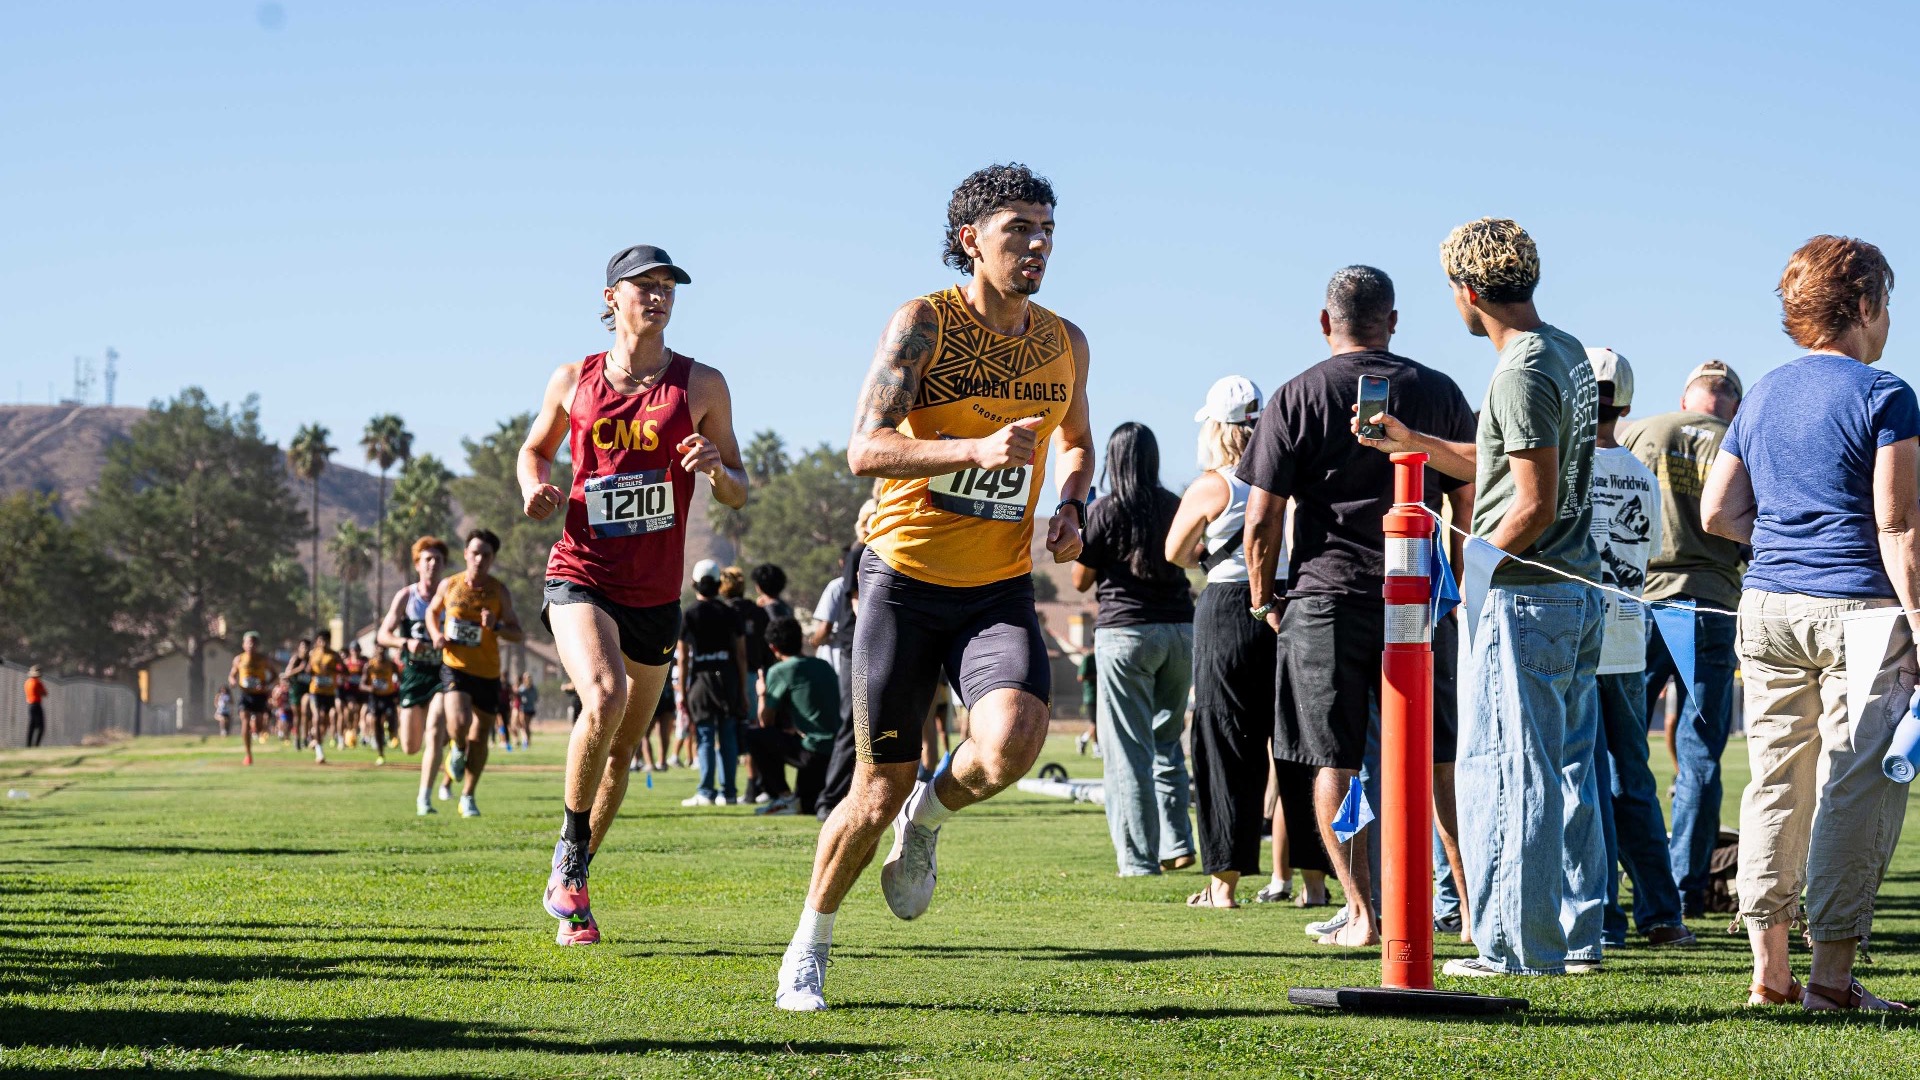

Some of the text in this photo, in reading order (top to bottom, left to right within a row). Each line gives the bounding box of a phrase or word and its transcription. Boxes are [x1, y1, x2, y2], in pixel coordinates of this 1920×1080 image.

[954, 377, 1067, 402] GOLDEN EAGLES
[973, 403, 1052, 424] CROSS COTRY
[592, 417, 659, 452] CMS
[617, 473, 644, 482] FINISHED
[617, 479, 643, 488] RESULTS
[950, 466, 1026, 500] 1149
[602, 485, 666, 521] 1210
